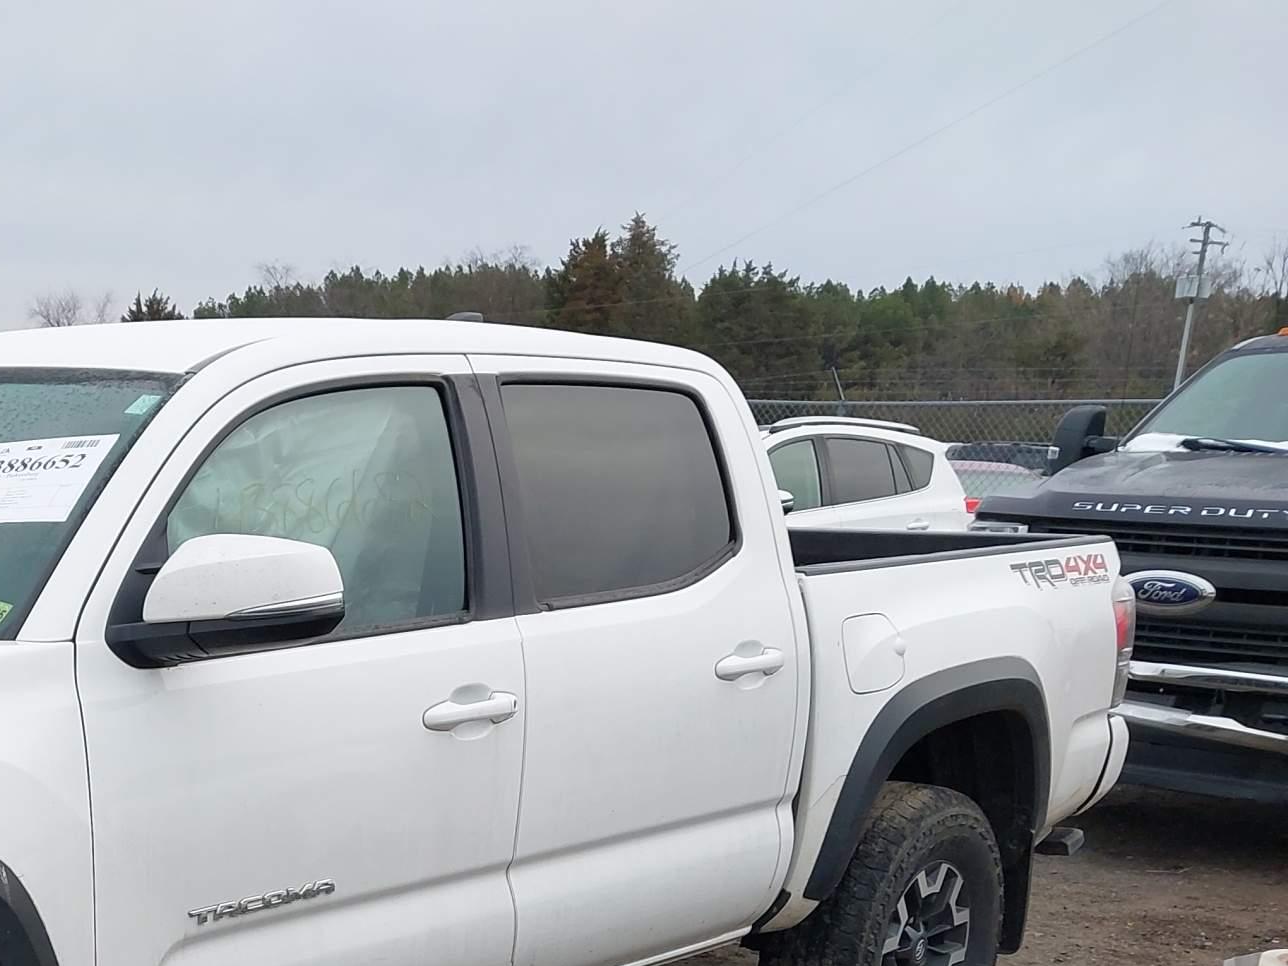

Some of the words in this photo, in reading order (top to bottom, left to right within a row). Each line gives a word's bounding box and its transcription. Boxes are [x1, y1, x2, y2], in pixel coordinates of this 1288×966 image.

[1071, 501, 1193, 516] SUPER
[1200, 506, 1288, 520] DUT
[1009, 558, 1067, 590] TRD
[1137, 580, 1187, 602] Ford
[187, 877, 337, 927] TACOMA
